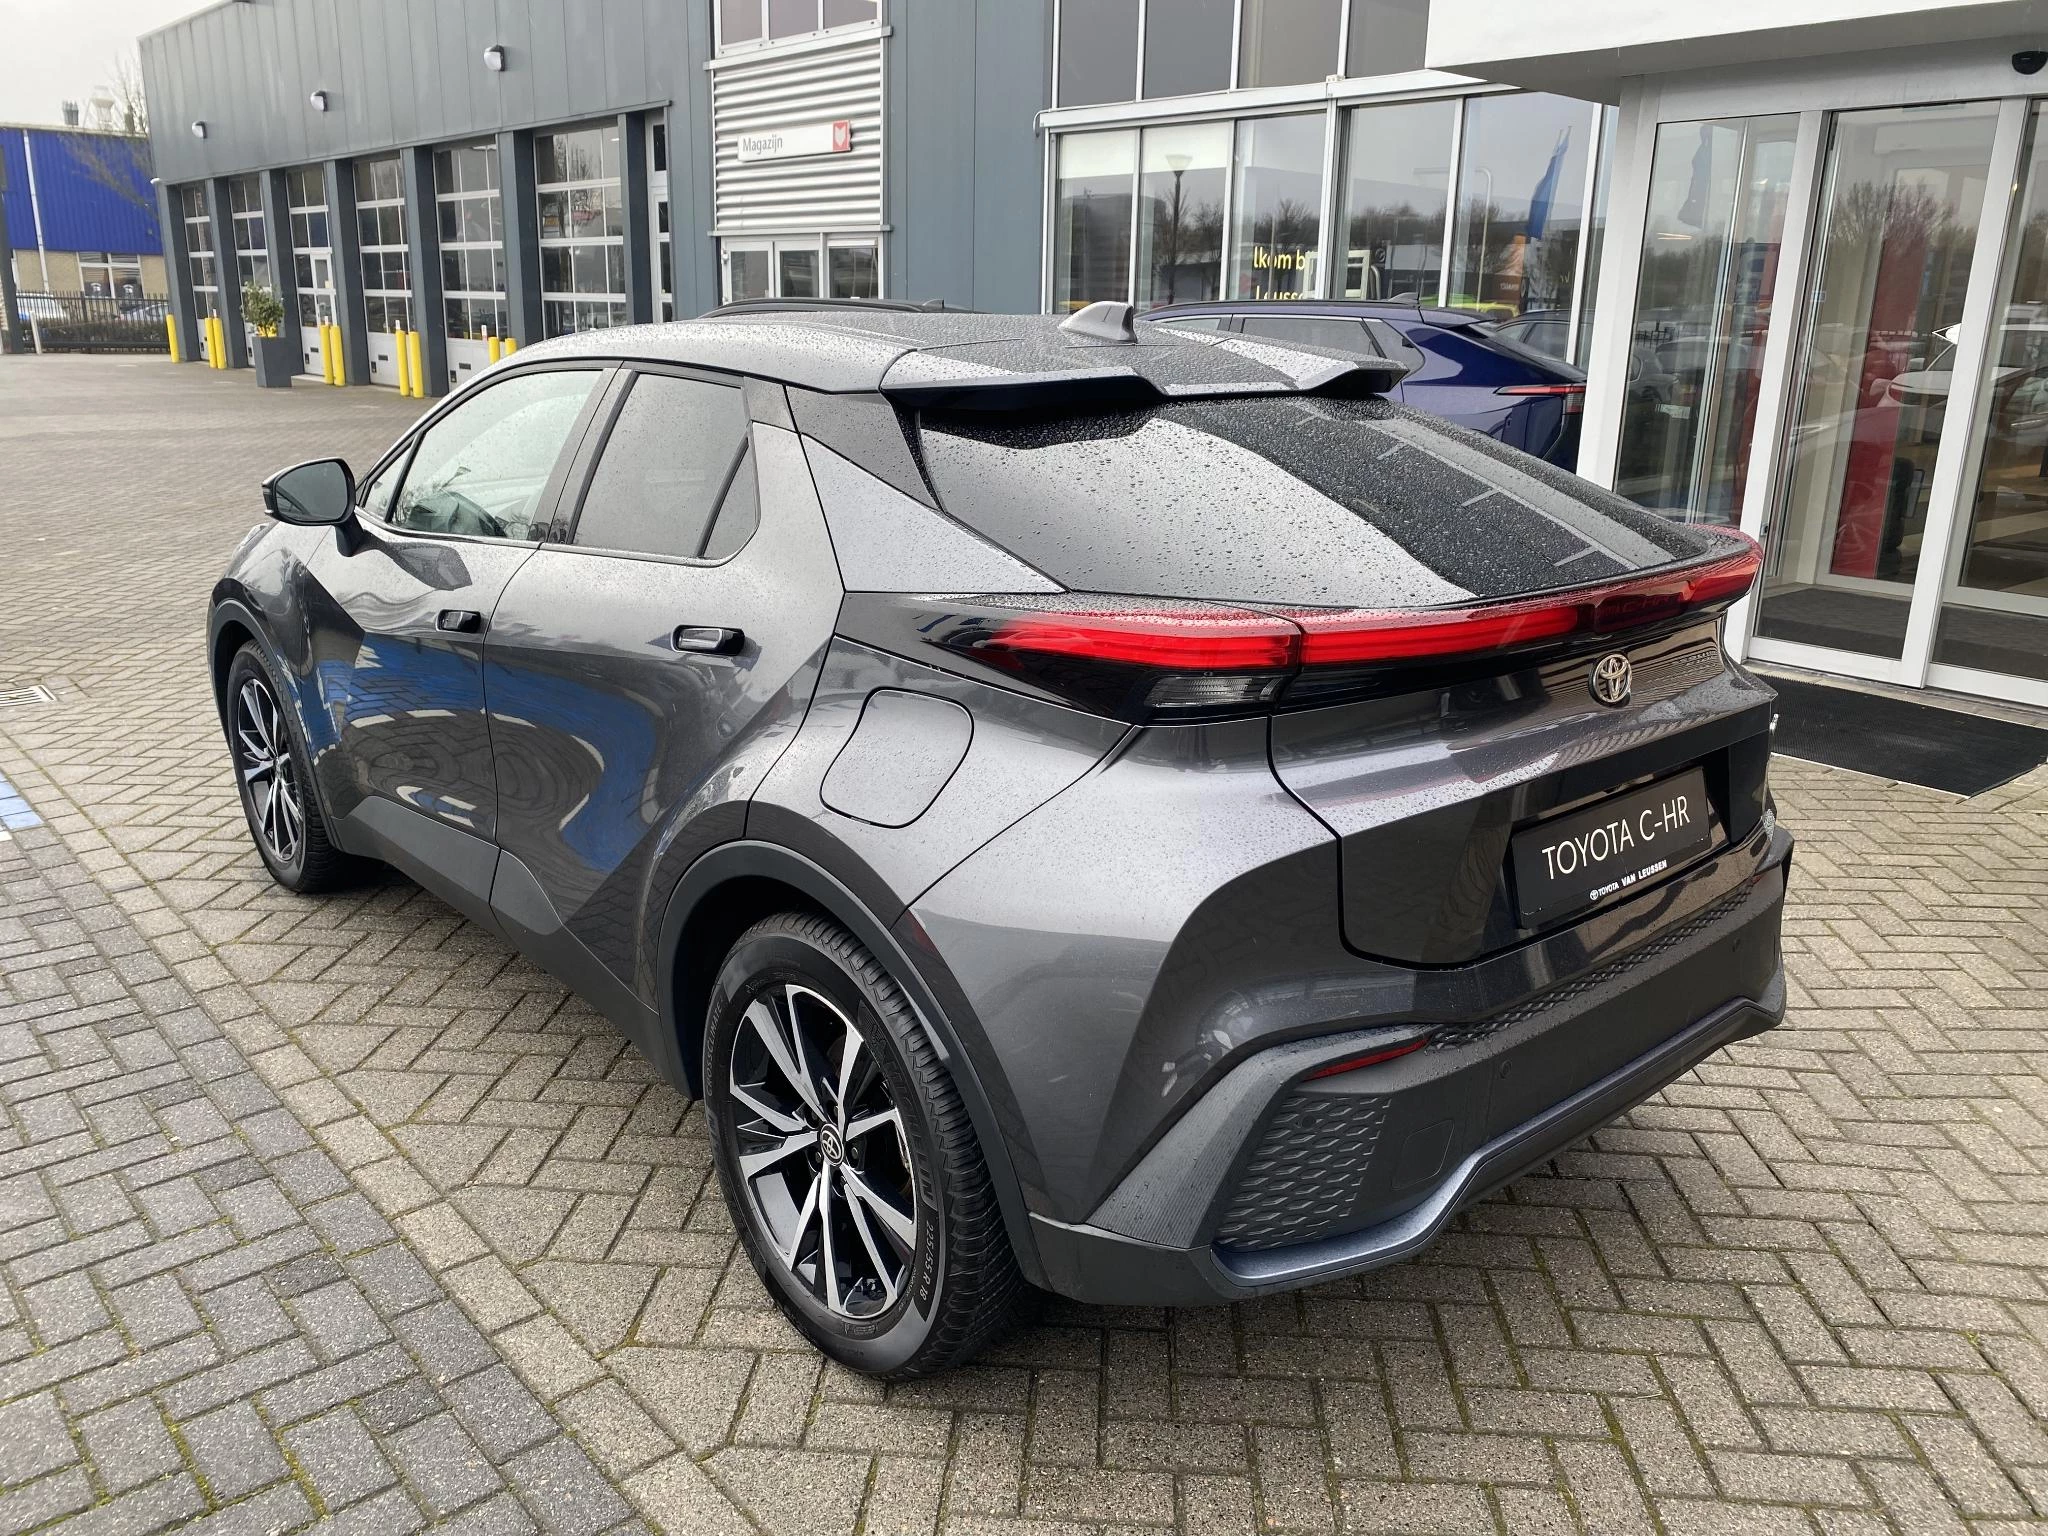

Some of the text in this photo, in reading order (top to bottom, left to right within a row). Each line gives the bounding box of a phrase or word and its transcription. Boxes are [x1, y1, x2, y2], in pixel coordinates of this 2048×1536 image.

[743, 134, 783, 155] Magazijn
[1542, 795, 1691, 880] TOYOTA C-HR
[1597, 859, 1668, 897] TOYOTA VAN LEUSSEN
[706, 1002, 724, 1097] CROSSCLIMATE
[919, 1220, 935, 1301] 225/55 R 18
